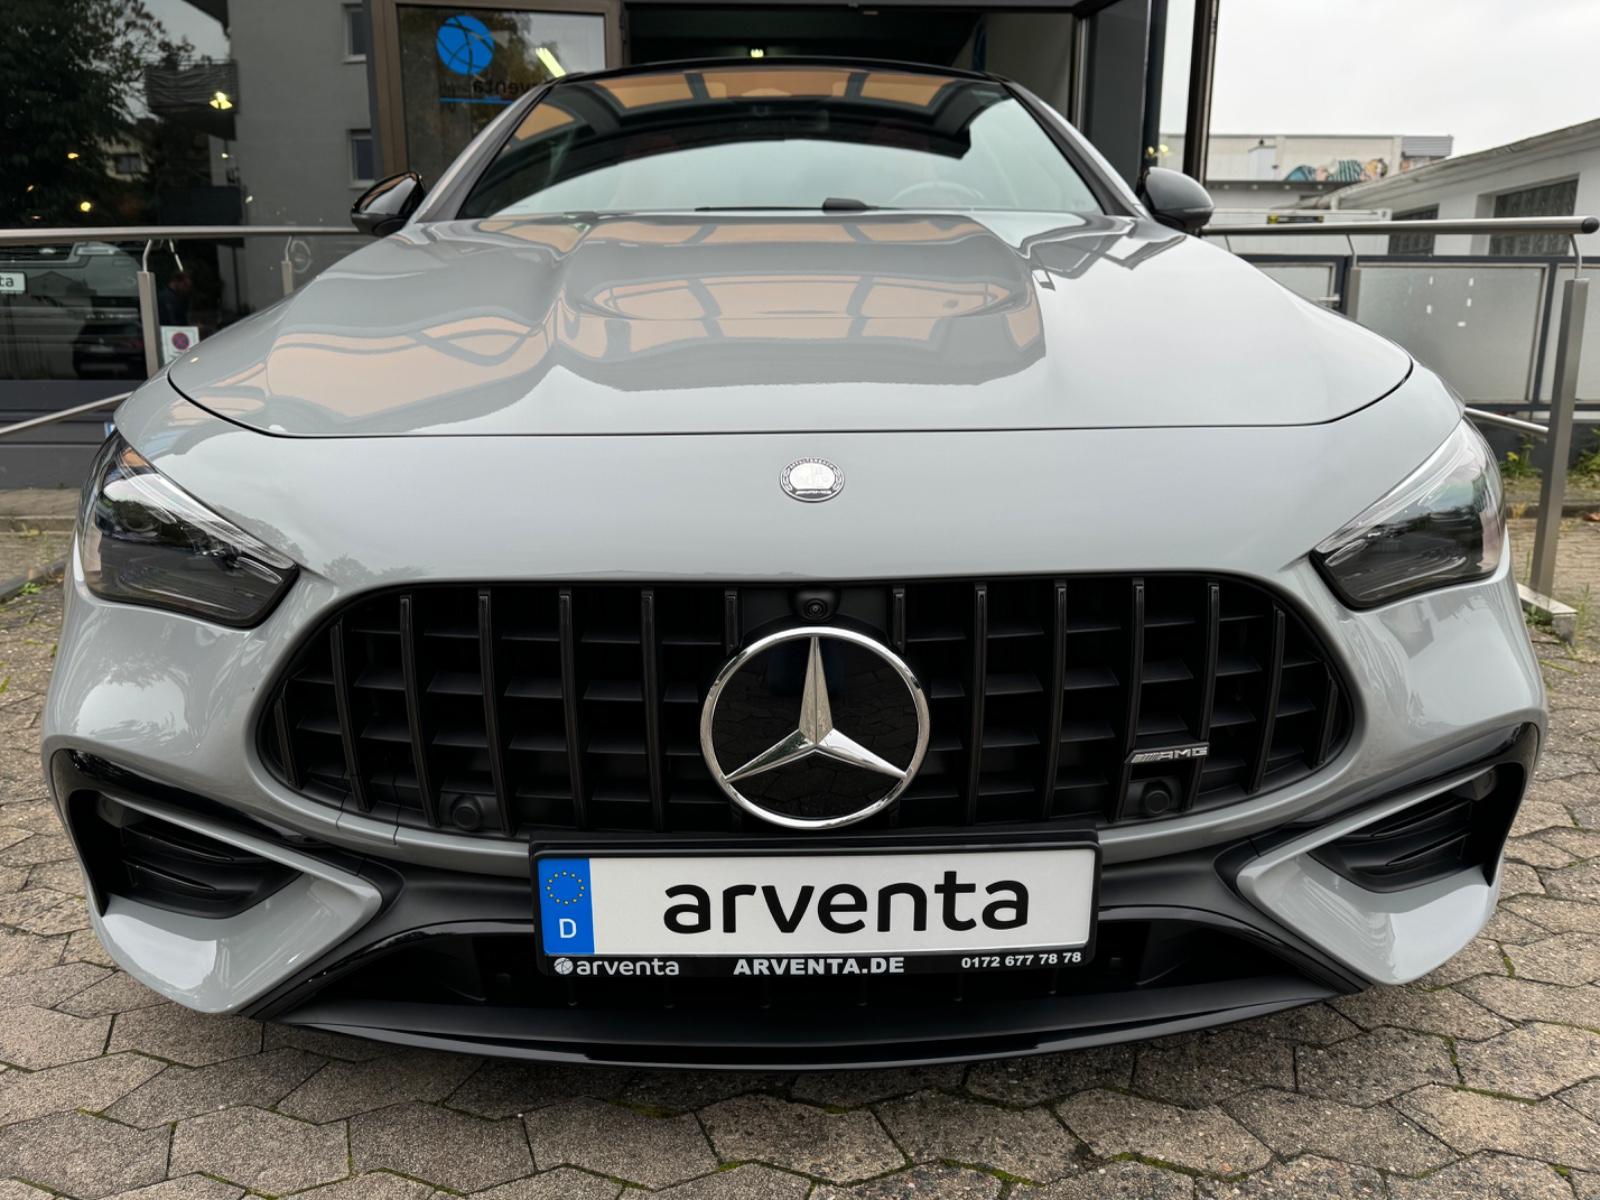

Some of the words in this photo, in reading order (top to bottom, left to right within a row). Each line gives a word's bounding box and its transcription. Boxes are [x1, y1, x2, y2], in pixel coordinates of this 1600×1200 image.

[1155, 746, 1208, 761] AMG
[664, 871, 1029, 934] arventa
[559, 918, 577, 938] D
[576, 958, 680, 976] arventa
[733, 957, 905, 975] ARVENTA.DE
[961, 956, 1001, 969] 0172
[1005, 954, 1034, 967] 677
[1039, 953, 1058, 965] 78
[1063, 951, 1082, 964] 78
